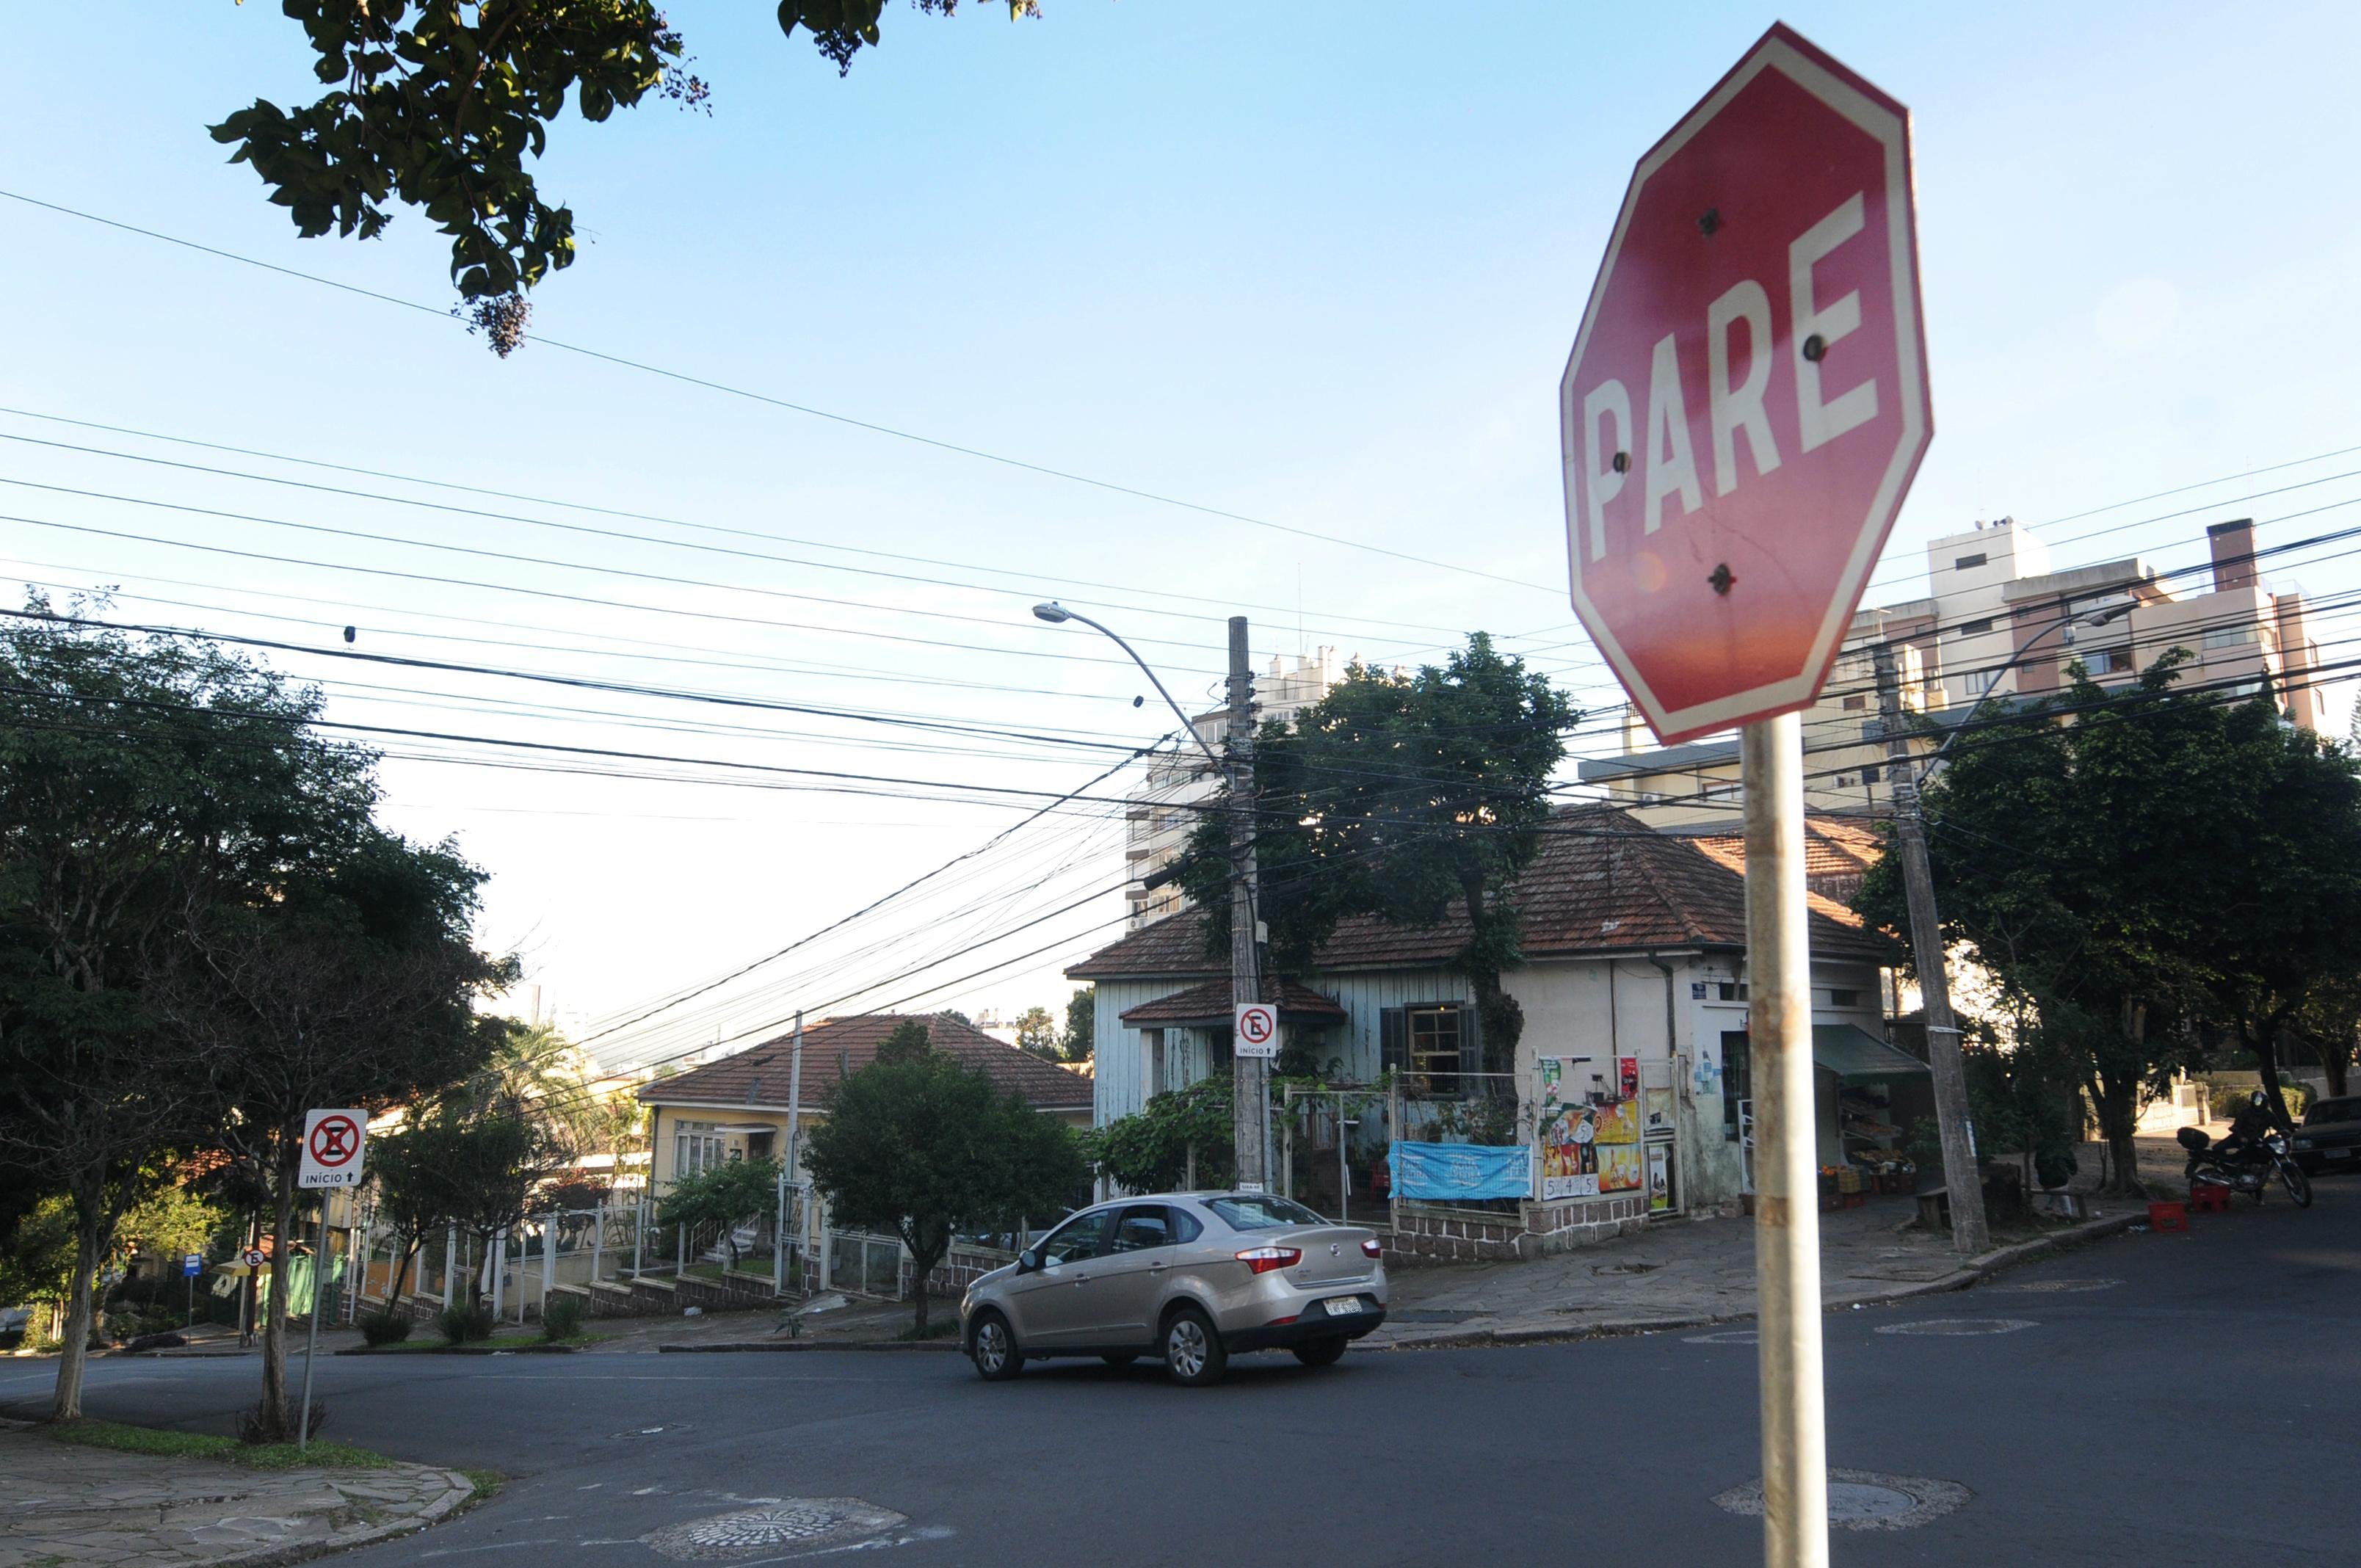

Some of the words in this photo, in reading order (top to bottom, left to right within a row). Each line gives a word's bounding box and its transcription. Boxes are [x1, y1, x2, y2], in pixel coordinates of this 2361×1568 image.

[1584, 189, 1879, 564] PARE
[1240, 1046, 1264, 1055] INÍCIO
[305, 1172, 342, 1184] INÍCIO
